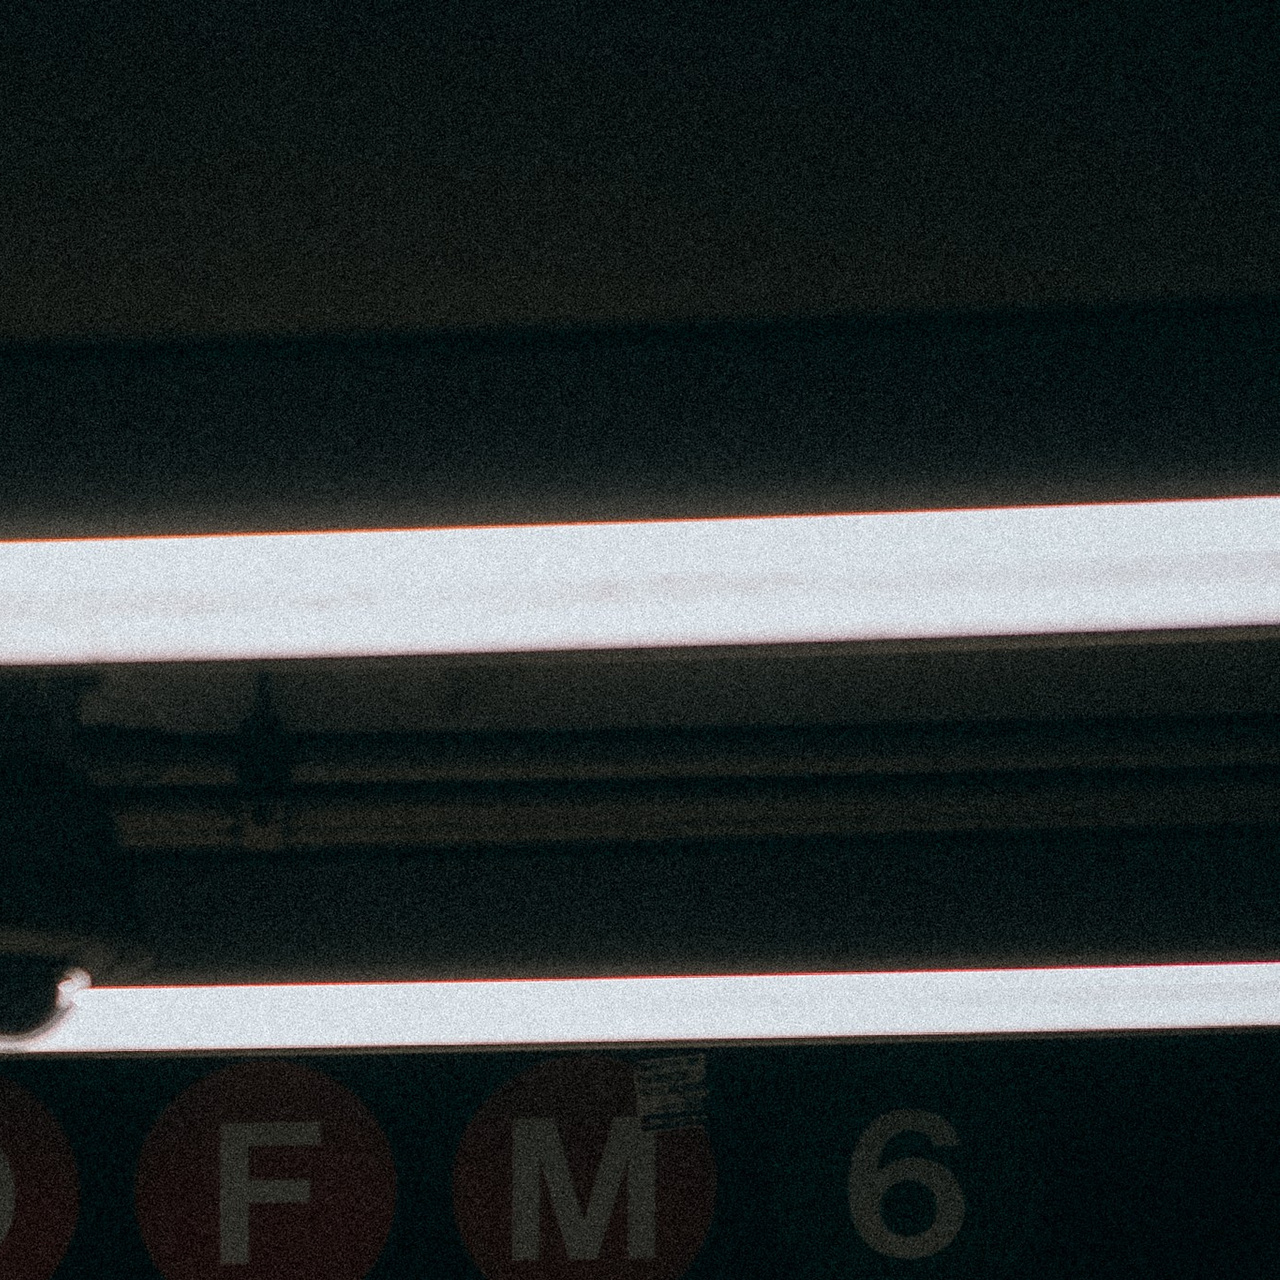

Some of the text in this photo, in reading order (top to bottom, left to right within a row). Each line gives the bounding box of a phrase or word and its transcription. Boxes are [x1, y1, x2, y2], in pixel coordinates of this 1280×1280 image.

[218, 1121, 323, 1267] F
[510, 1116, 659, 1262] M
[847, 1108, 966, 1260] 6
